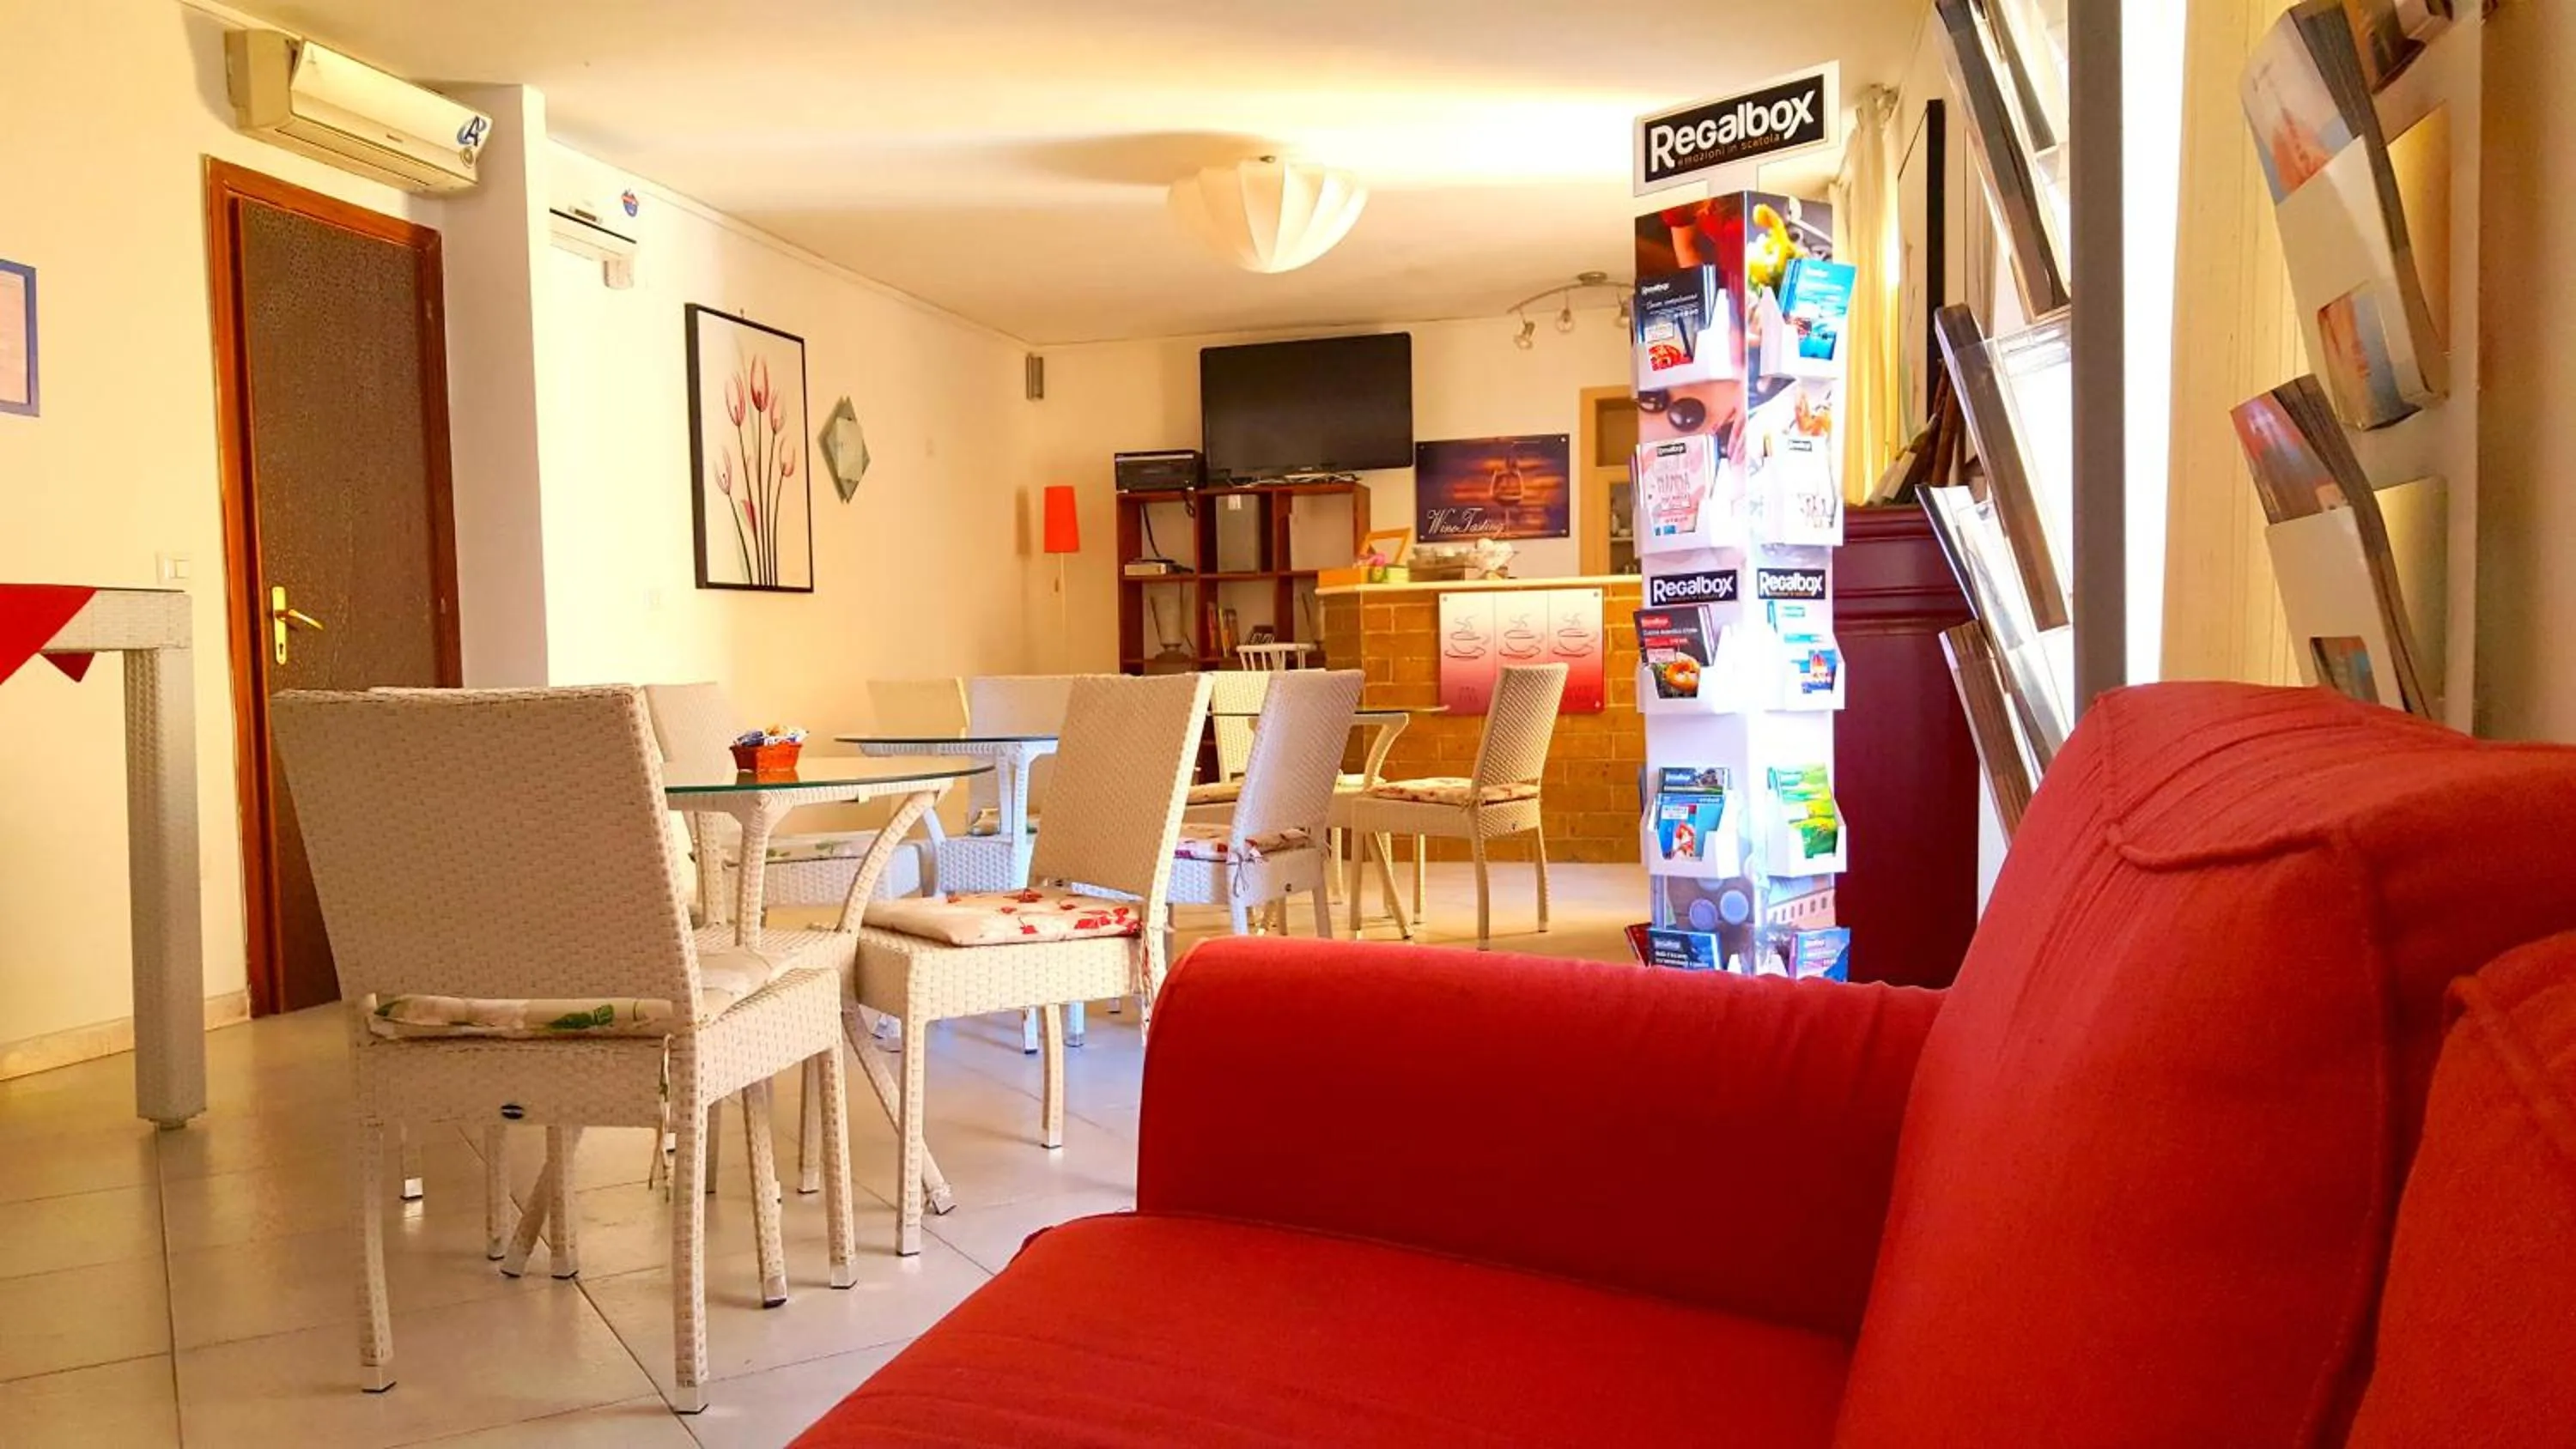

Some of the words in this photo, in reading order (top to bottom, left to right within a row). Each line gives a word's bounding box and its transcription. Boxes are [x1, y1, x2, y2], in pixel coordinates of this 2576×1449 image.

[1741, 134, 1780, 151] scatola
[1426, 508, 1461, 535] Wine
[1462, 507, 1505, 539] Tasting
